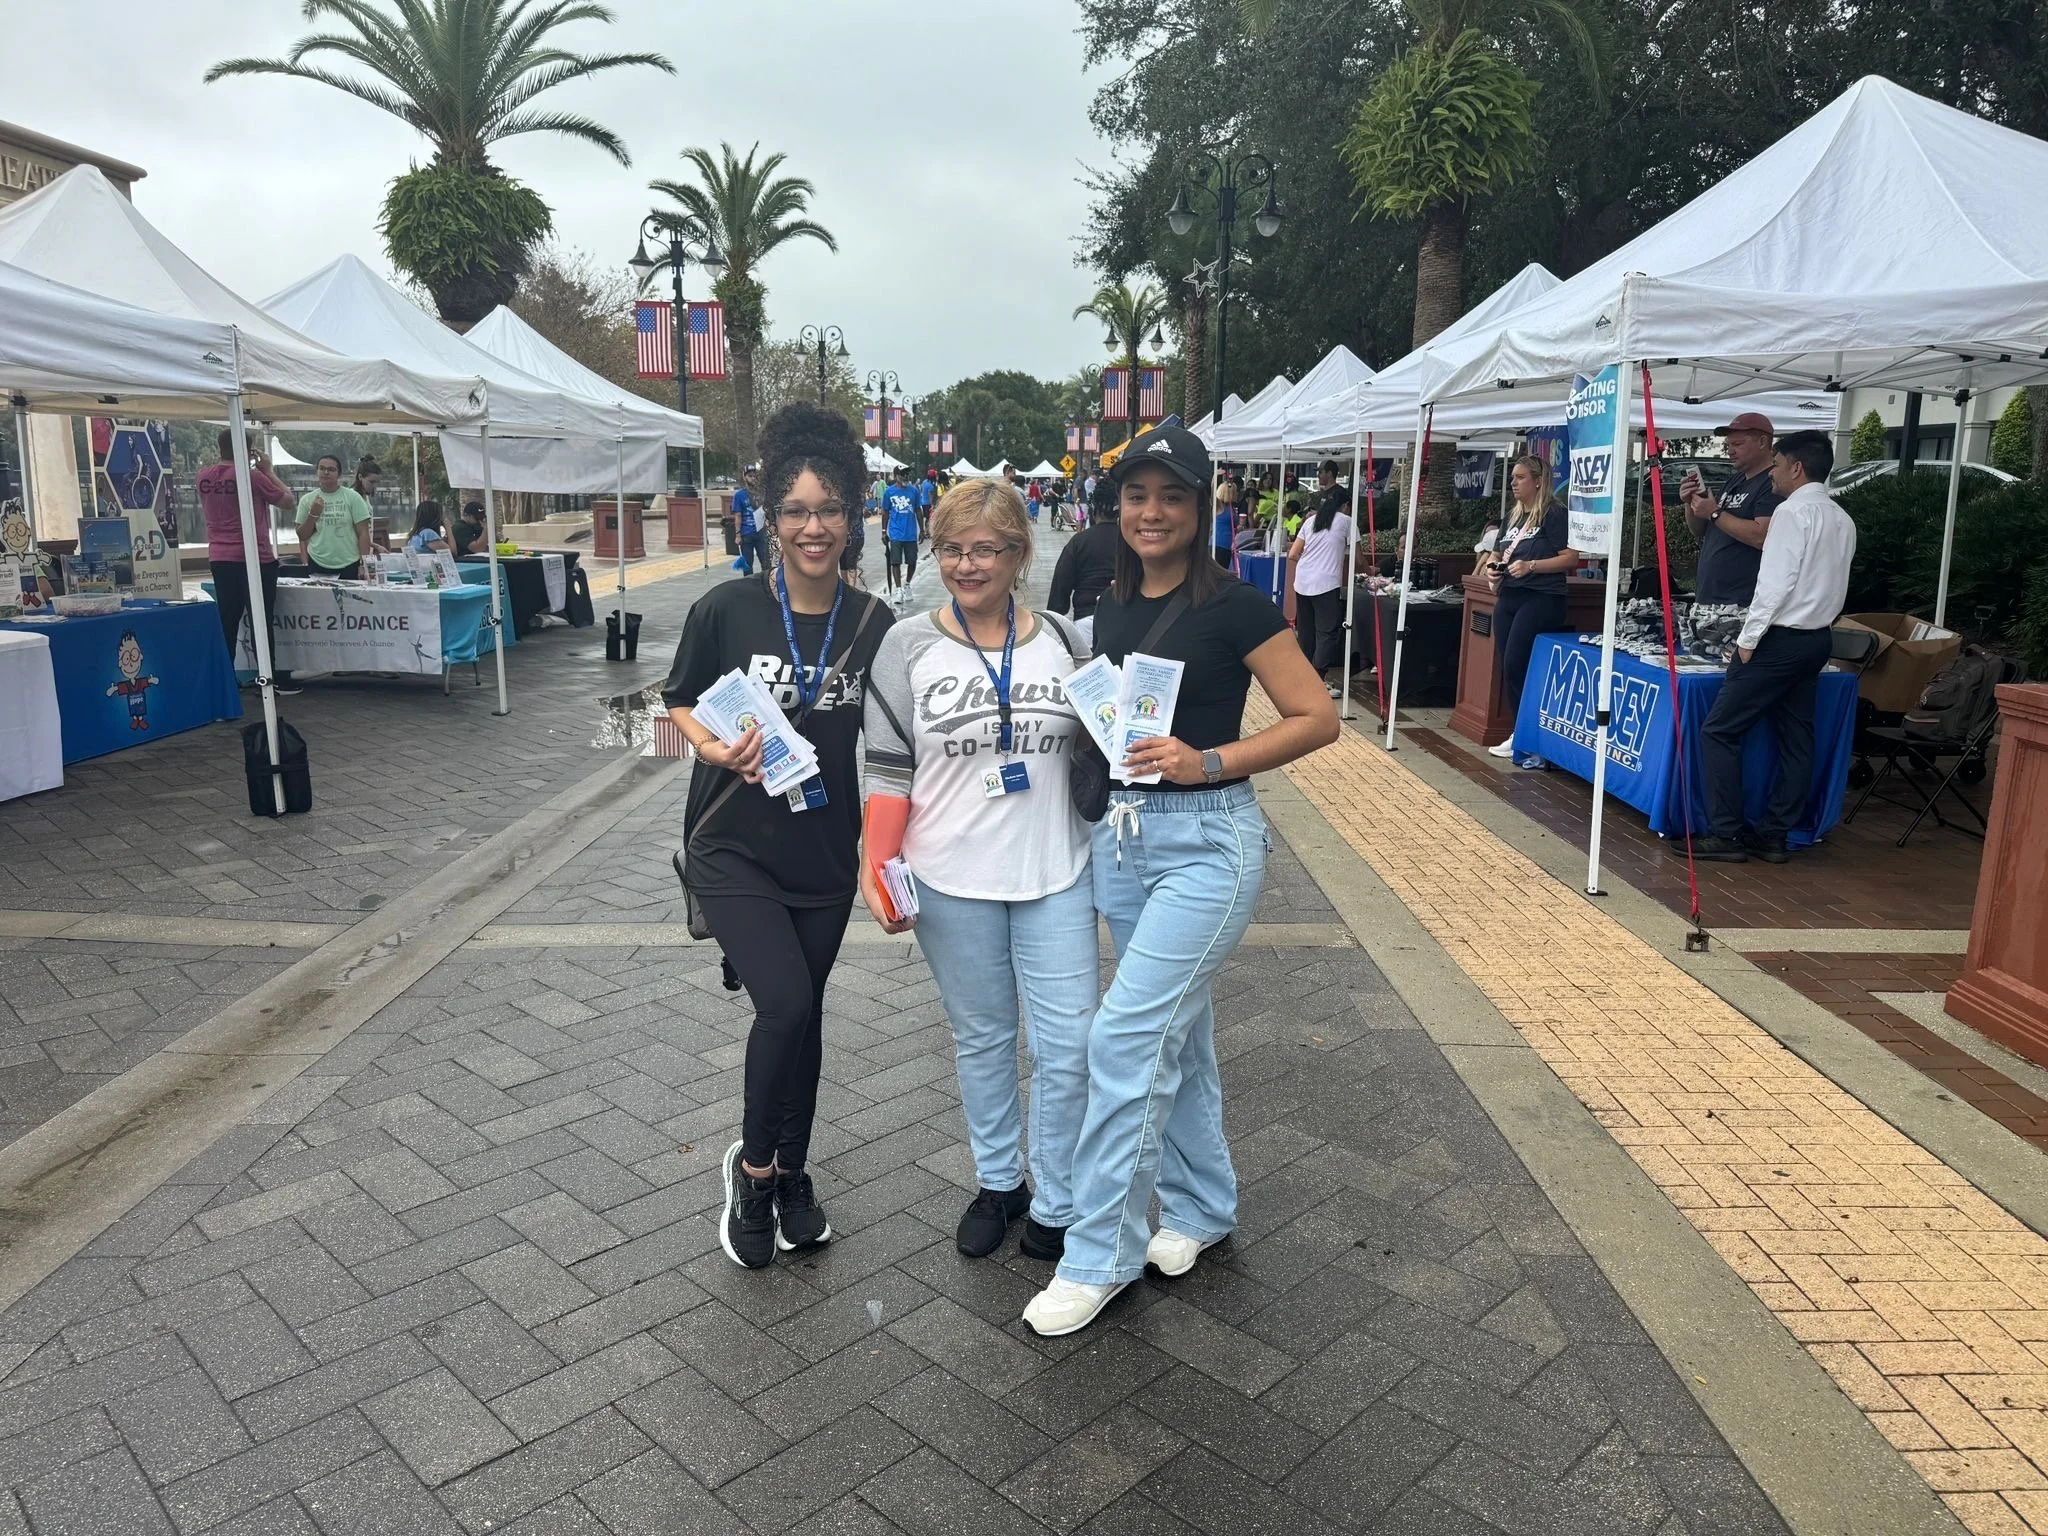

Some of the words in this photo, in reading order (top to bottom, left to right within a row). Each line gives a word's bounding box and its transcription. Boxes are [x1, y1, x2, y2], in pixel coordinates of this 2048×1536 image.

[326, 616, 338, 630] 2
[346, 615, 409, 631] DANCE
[1014, 720, 1043, 733] MY
